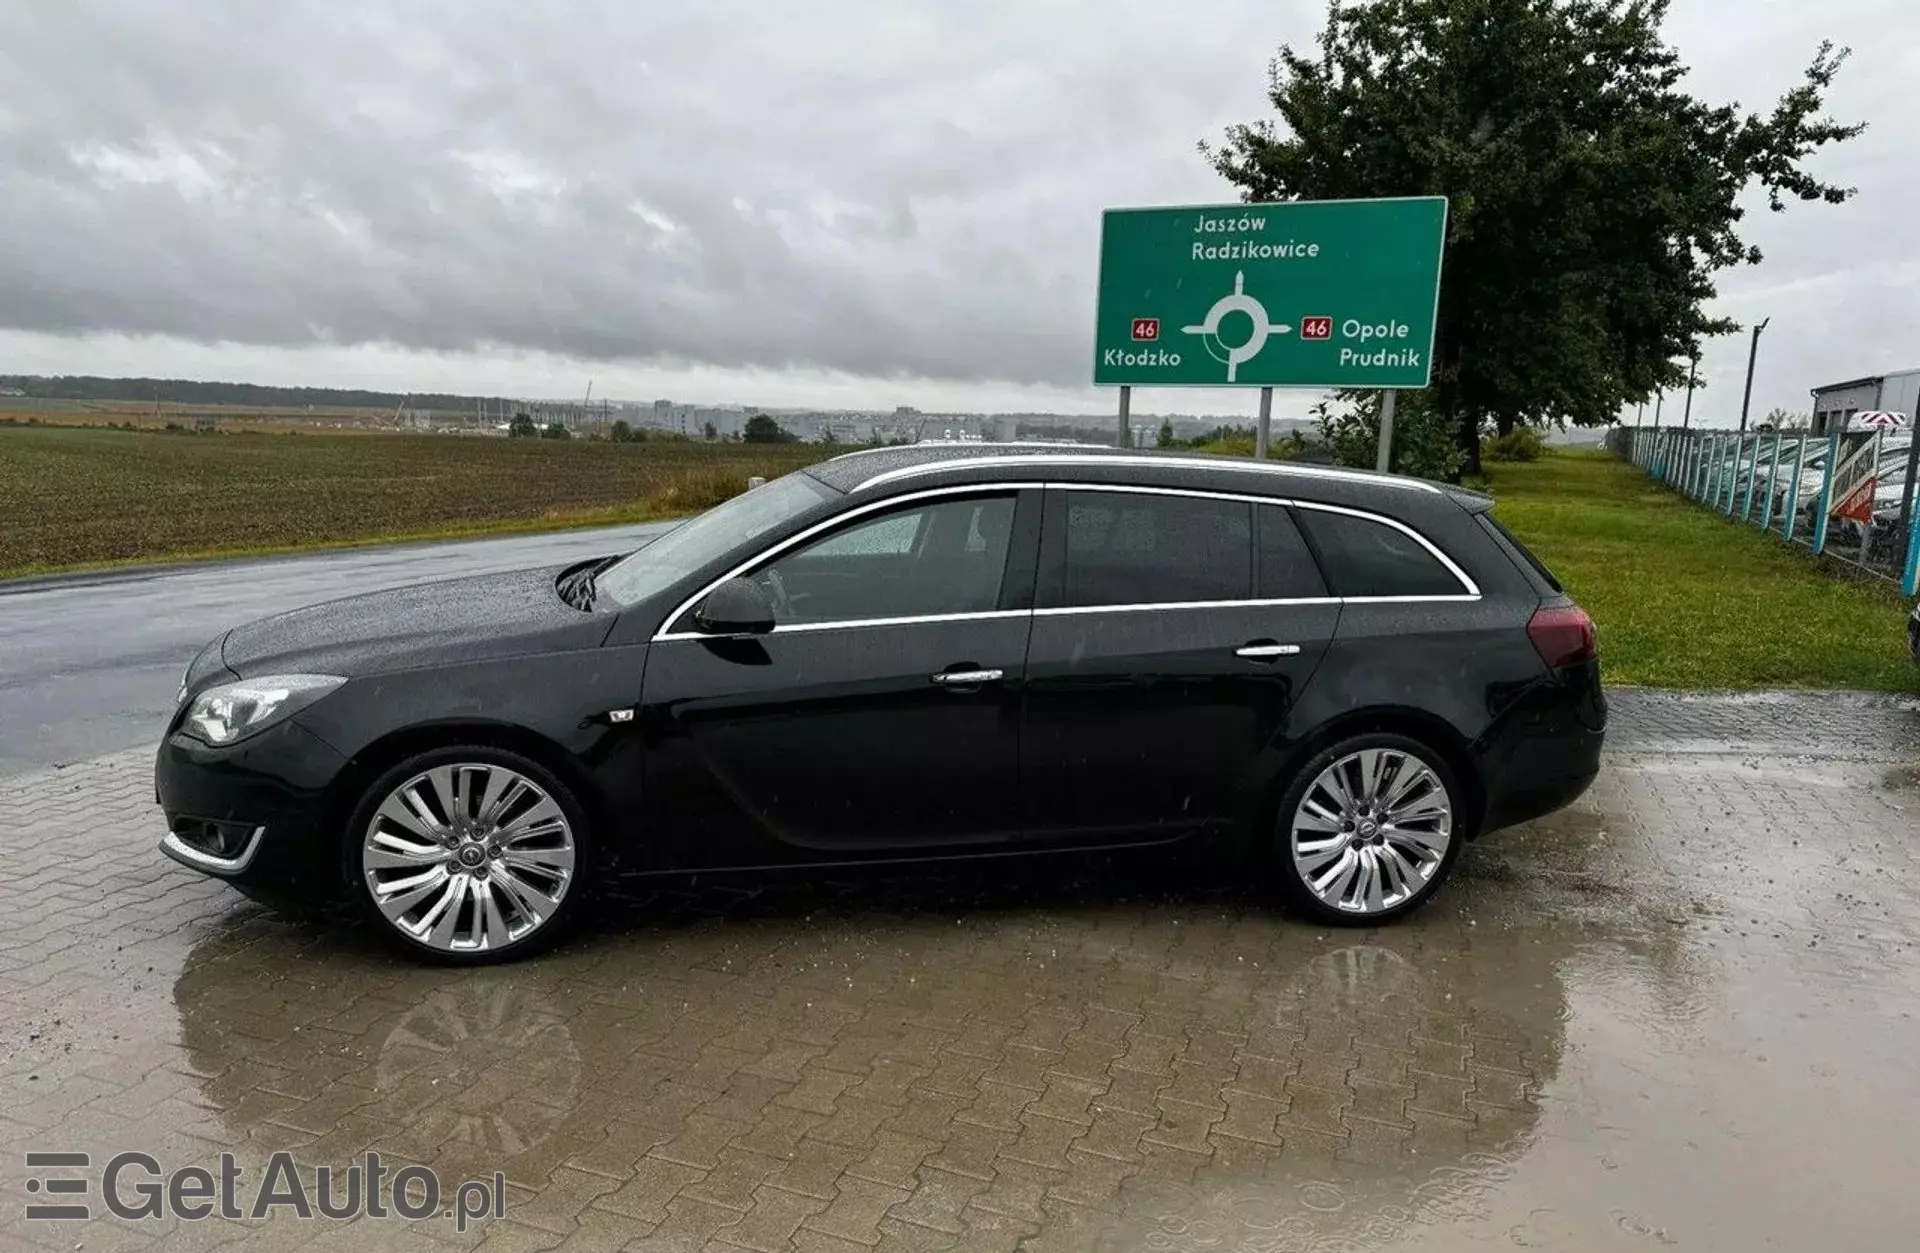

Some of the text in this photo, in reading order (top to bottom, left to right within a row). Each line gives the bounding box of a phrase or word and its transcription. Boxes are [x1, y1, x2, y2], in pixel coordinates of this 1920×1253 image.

[1195, 214, 1266, 233] Jaszów
[1192, 241, 1320, 261] Radzikowice
[1136, 321, 1156, 338] 46
[1306, 319, 1328, 336] 46
[1342, 319, 1409, 343] Opole
[1104, 349, 1182, 368] Kłodzko
[1340, 348, 1420, 368] Prudnik
